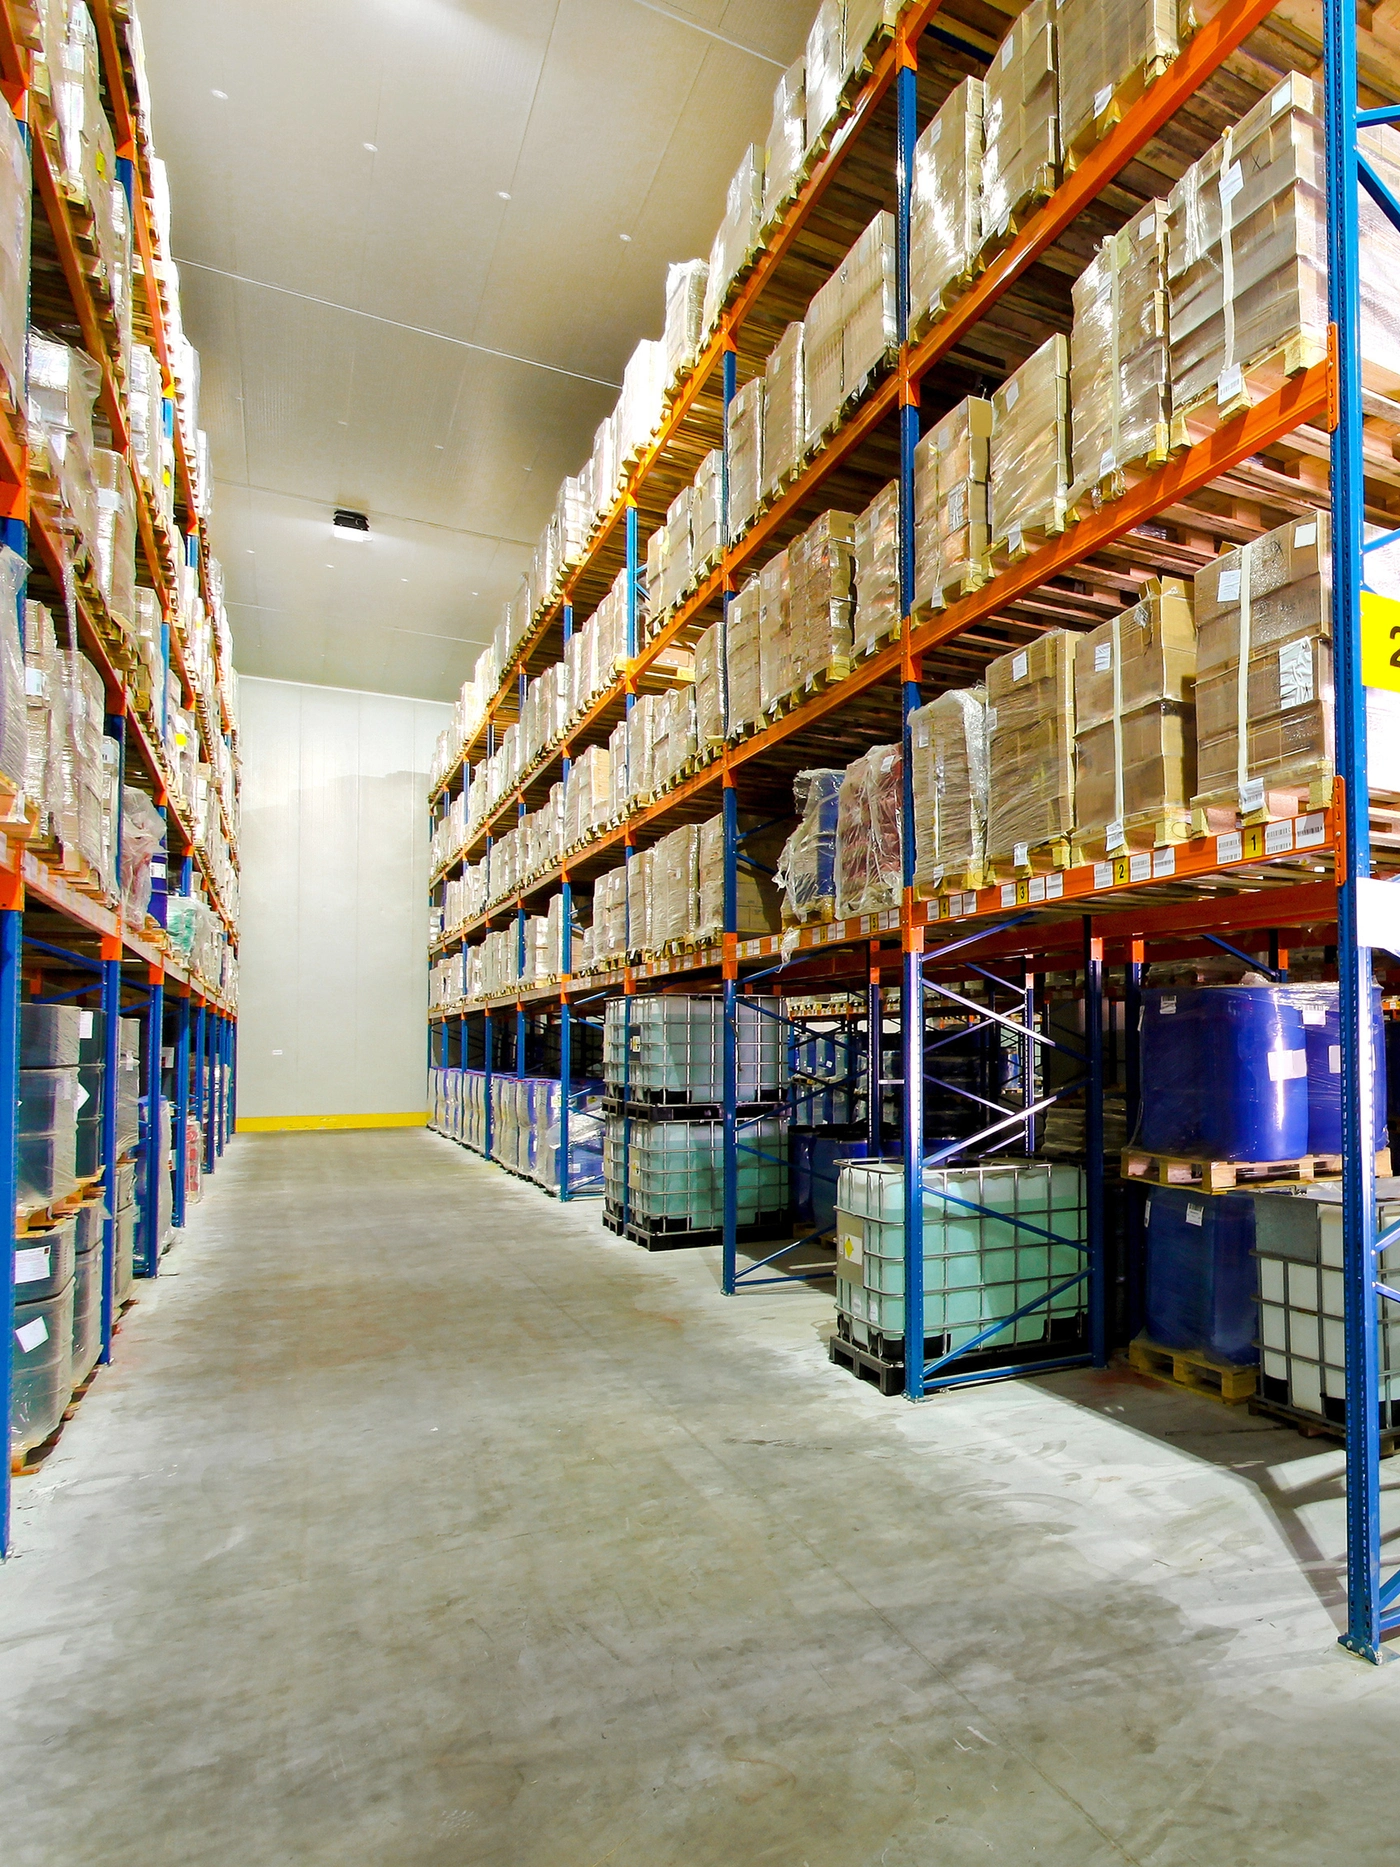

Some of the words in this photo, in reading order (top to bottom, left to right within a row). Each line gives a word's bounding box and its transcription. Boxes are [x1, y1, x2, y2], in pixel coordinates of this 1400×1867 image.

[1251, 834, 1256, 851] 1
[1118, 864, 1124, 879] 2
[1020, 886, 1025, 900] 3
[942, 902, 947, 914] 4
